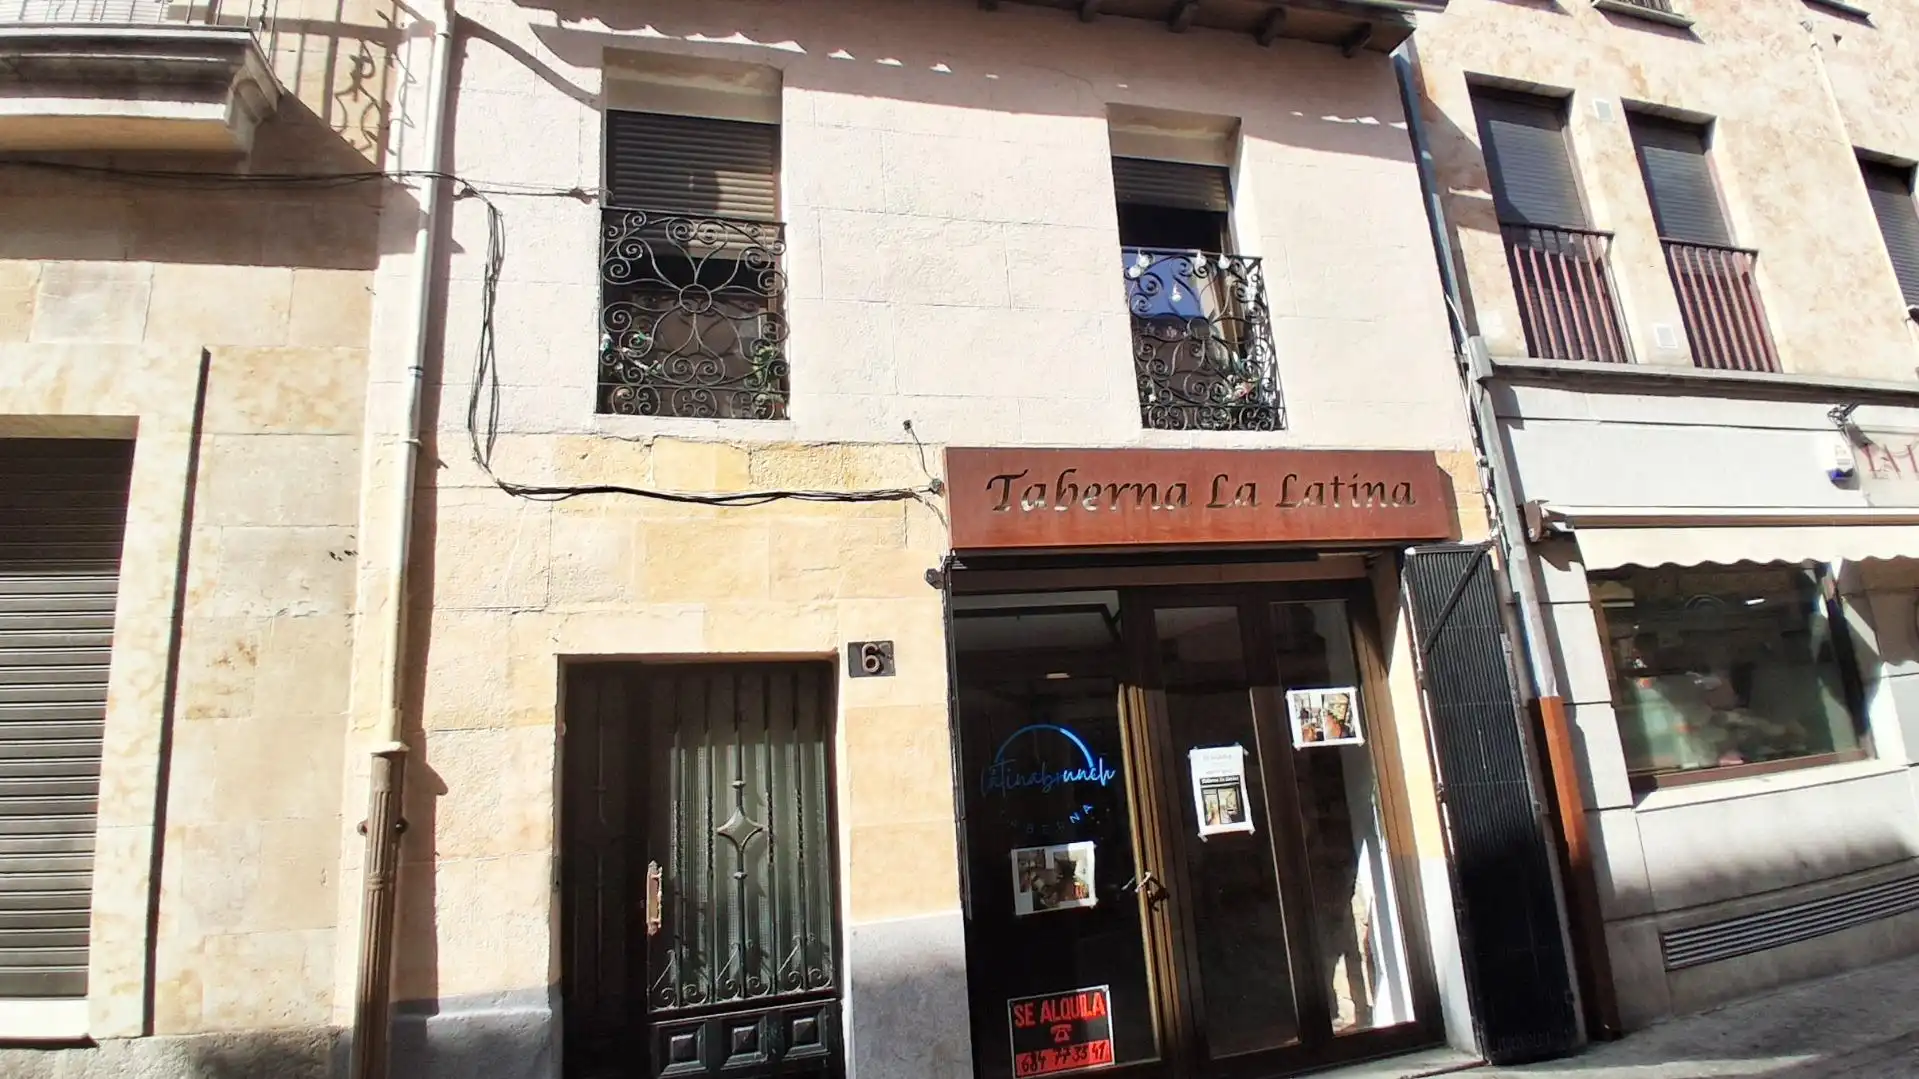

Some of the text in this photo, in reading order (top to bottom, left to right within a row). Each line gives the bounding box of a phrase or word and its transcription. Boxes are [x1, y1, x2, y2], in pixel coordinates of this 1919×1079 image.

[986, 468, 1417, 511] Taberna La Latina
[861, 642, 881, 673] 6
[1013, 991, 1106, 1029] SE ALQUILA
